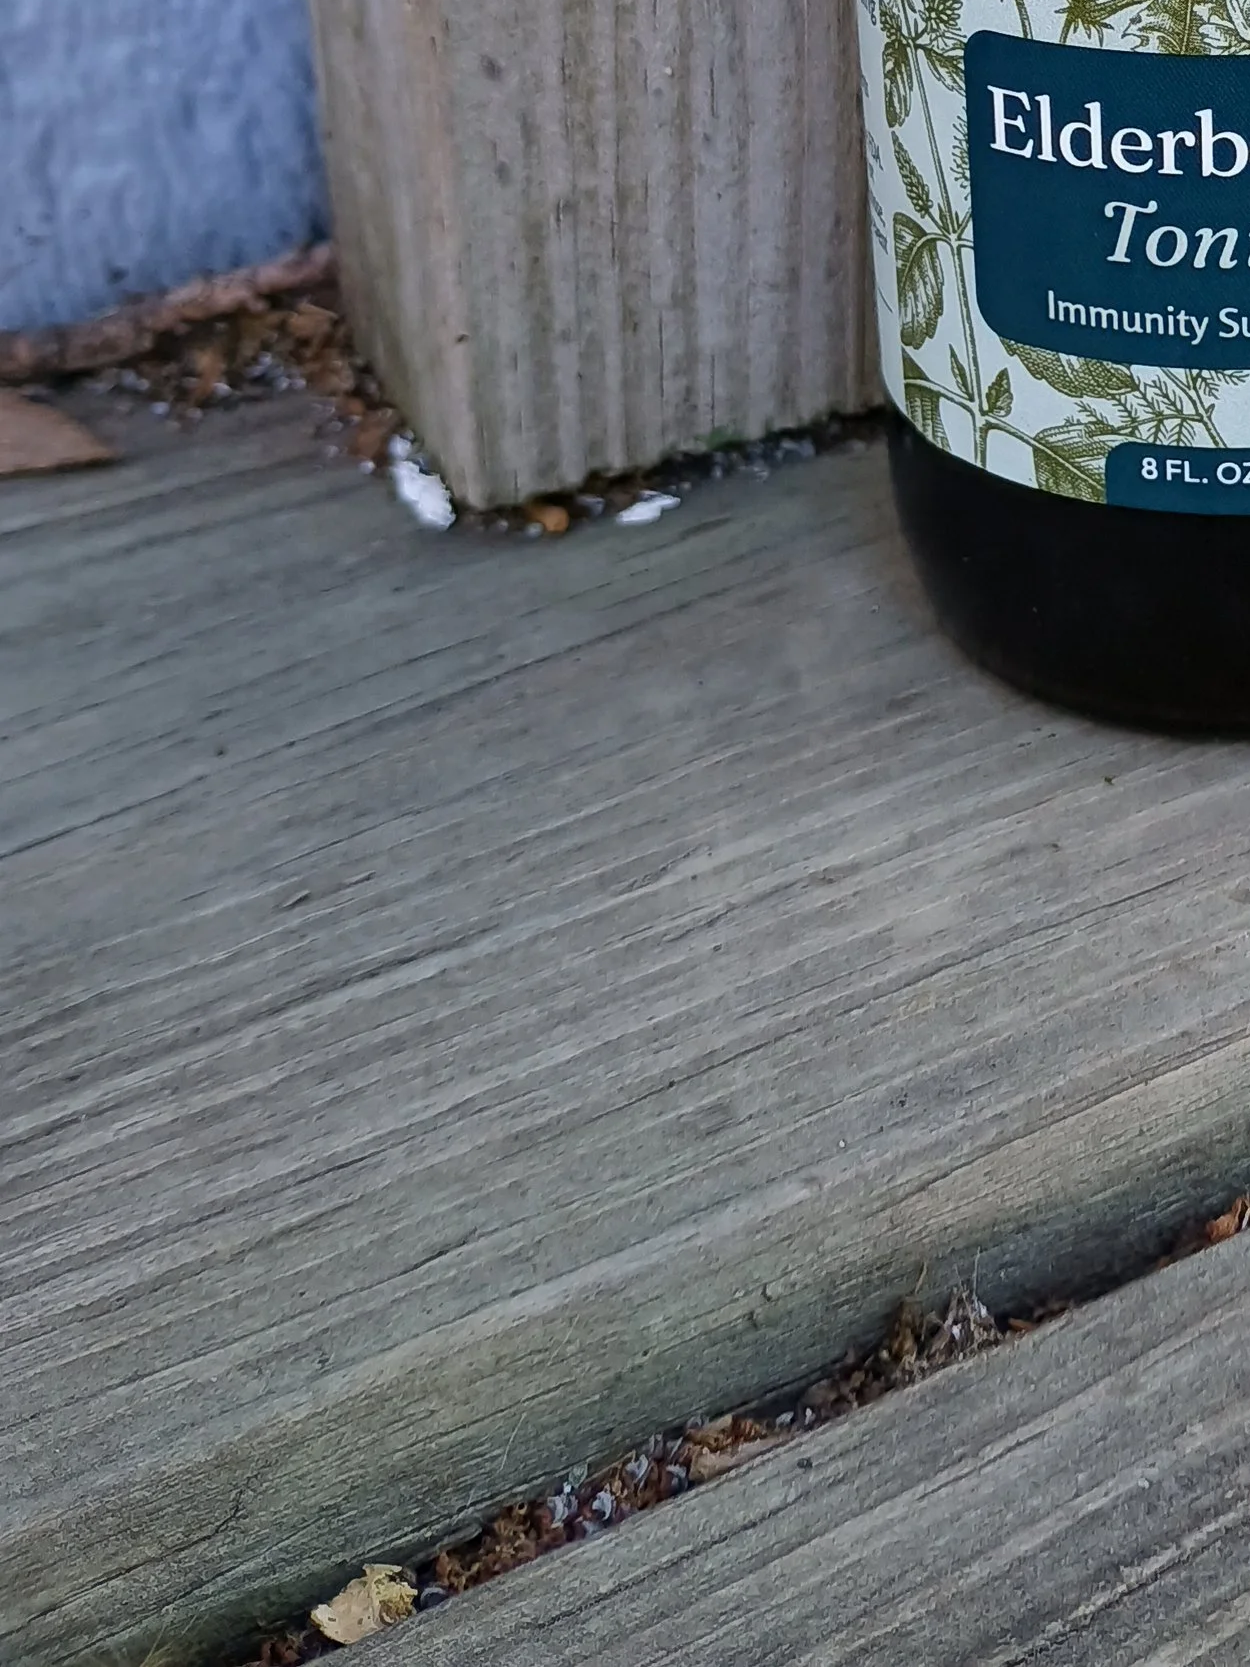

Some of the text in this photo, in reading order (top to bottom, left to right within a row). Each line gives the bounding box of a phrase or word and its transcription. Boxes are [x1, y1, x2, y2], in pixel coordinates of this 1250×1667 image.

[1047, 290, 1209, 345] Immunity
[1141, 458, 1158, 479] 8
[1167, 462, 1208, 483] FL.
